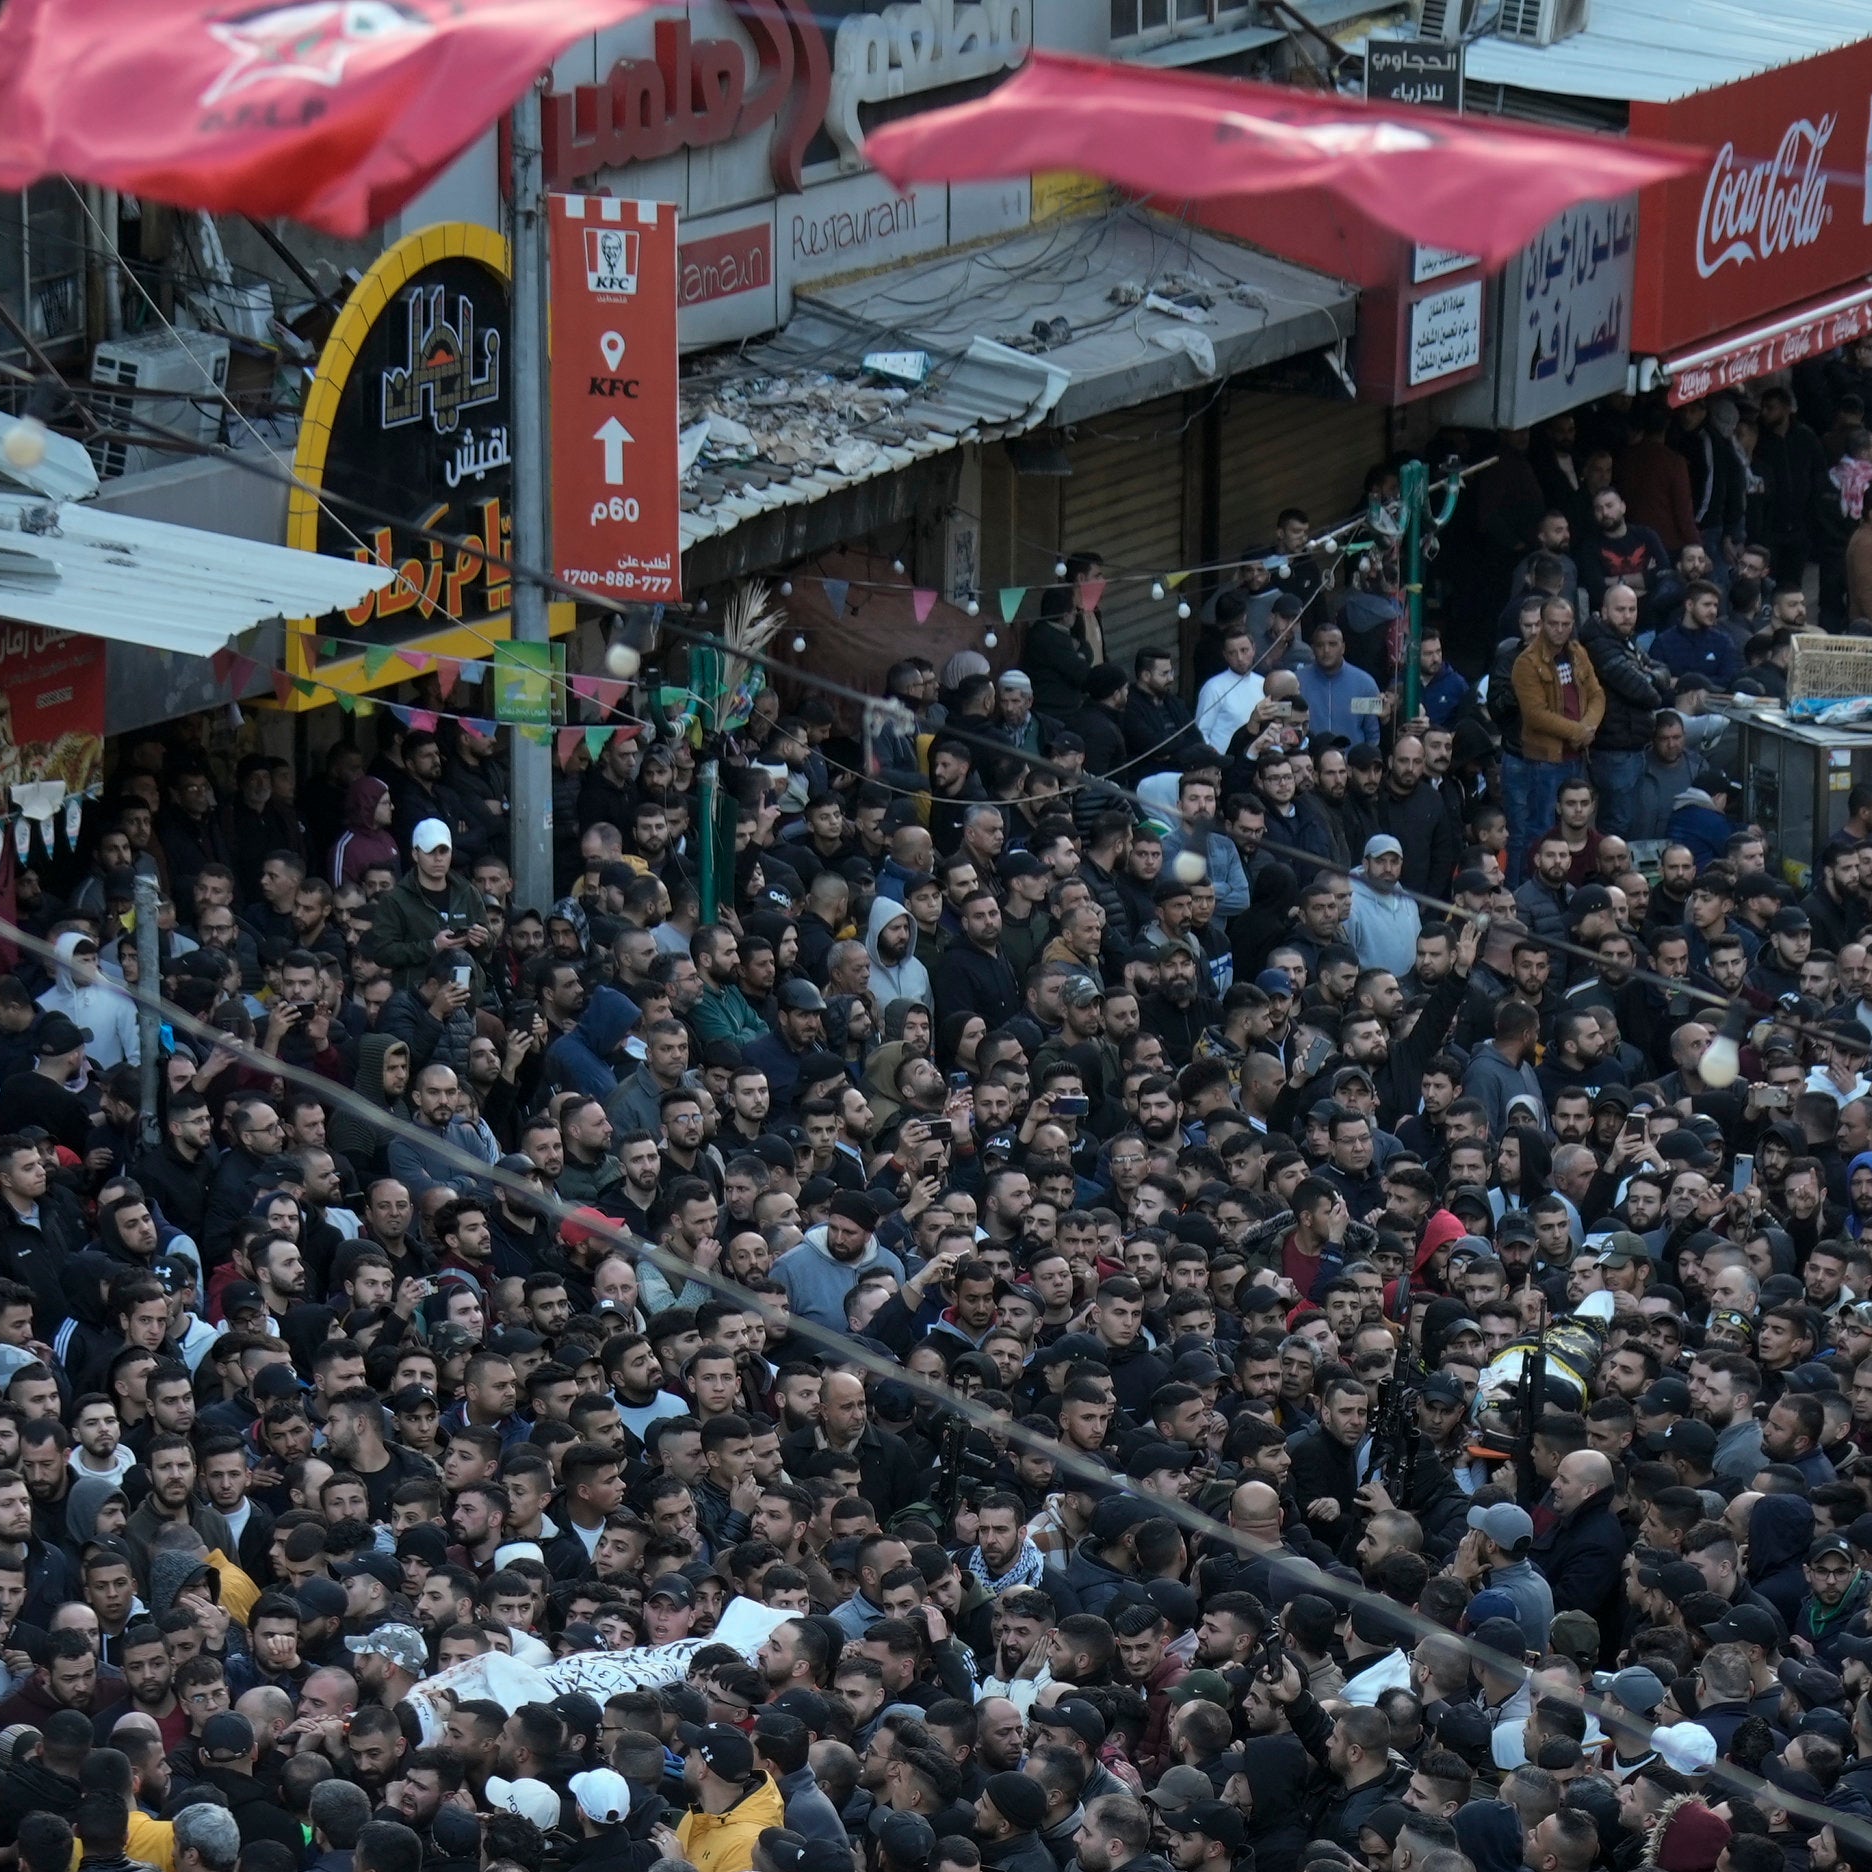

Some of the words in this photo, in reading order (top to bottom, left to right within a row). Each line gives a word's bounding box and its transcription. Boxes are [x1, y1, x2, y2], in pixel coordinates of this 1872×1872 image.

[1372, 50, 1456, 74] الحجاوي
[1696, 111, 1838, 278] Coca-Cola
[595, 277, 629, 291] KFC
[588, 377, 641, 399] KFC
[618, 554, 639, 570] على
[640, 553, 671, 571] أطلب
[562, 568, 672, 593] 1700-888-777
[986, 1137, 1011, 1150] FILA
